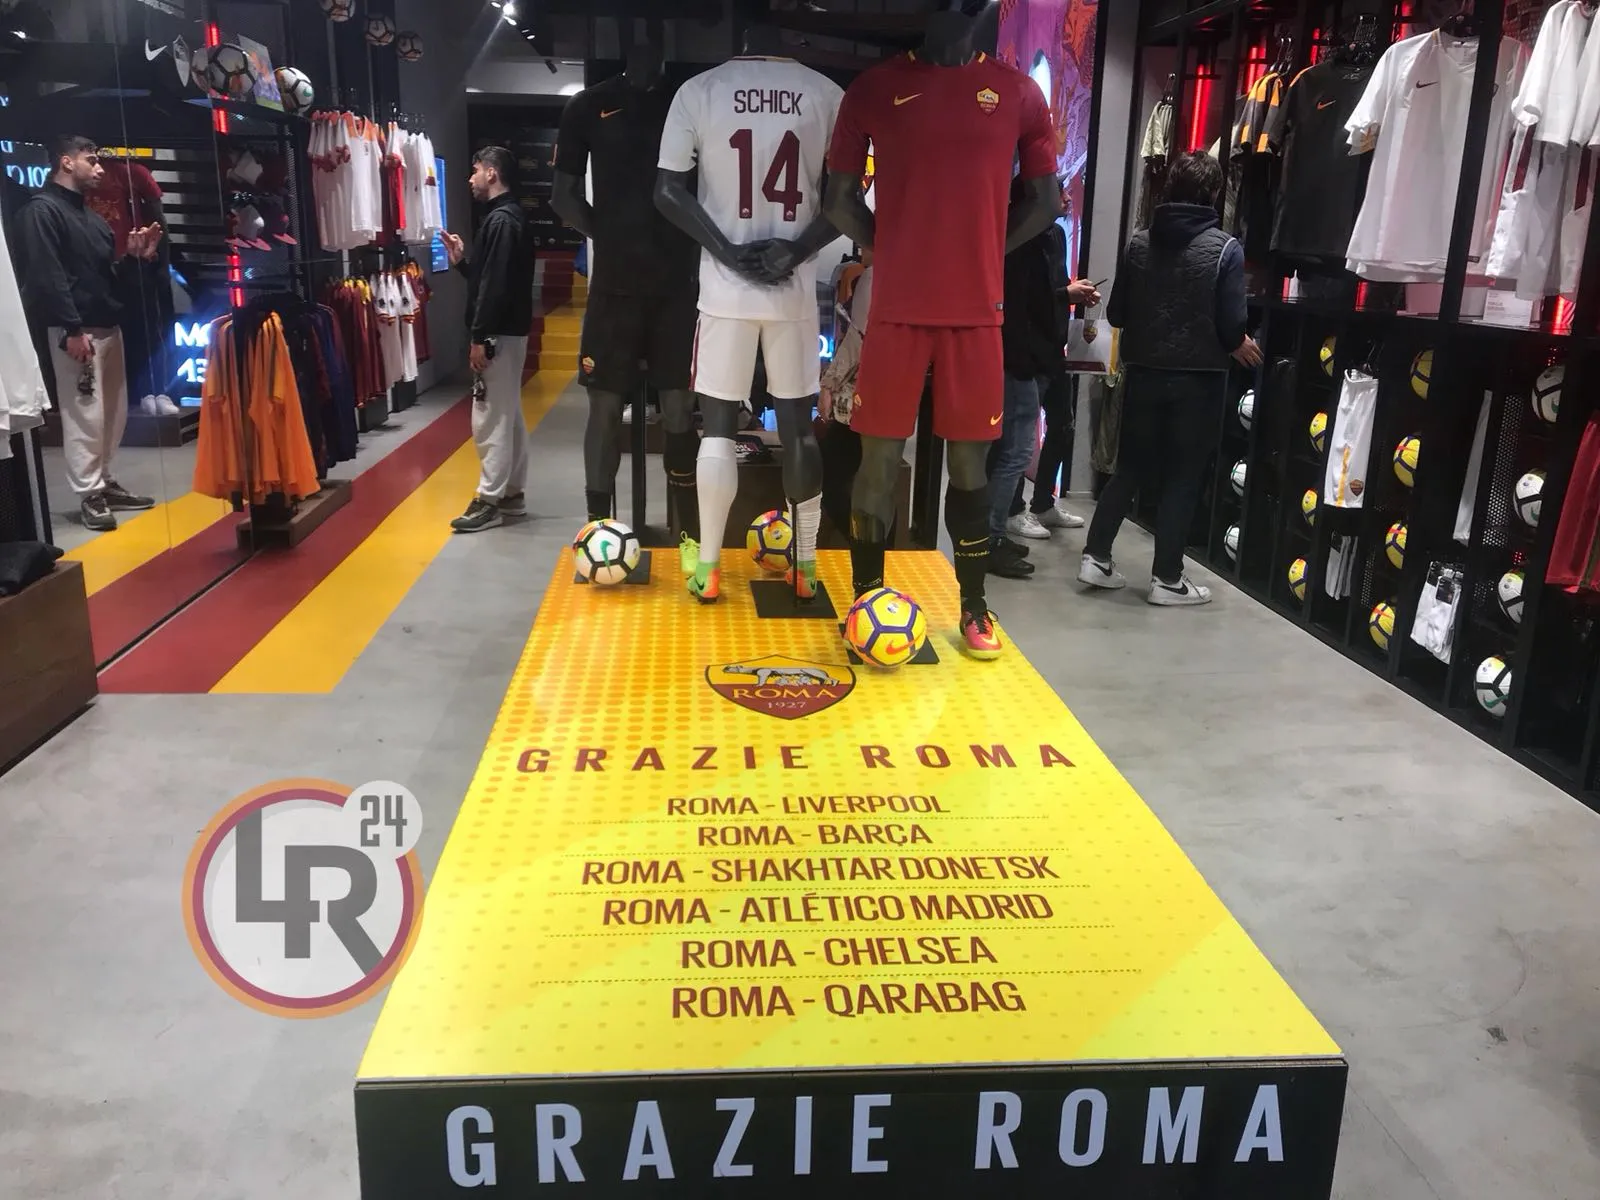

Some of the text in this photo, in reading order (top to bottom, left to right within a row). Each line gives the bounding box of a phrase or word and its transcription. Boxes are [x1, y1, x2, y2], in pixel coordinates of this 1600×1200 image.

[733, 88, 803, 116] SCHICK
[728, 128, 803, 222] 14
[732, 688, 838, 699] ROMA
[767, 701, 807, 709] 1927
[516, 744, 1076, 772] GRAZIE ROMA
[667, 797, 759, 816] ROMA
[782, 795, 951, 814] LIVERPOOL
[698, 826, 795, 847] ROMA
[818, 824, 933, 846] BARÇA
[582, 861, 685, 885] ROMA
[711, 857, 896, 882] SHAKHTAR
[898, 856, 1060, 881] DONETSK
[602, 898, 711, 926] ROMA
[740, 892, 906, 923] ATLÉTICO
[909, 894, 1054, 921] MADRID
[681, 939, 796, 969] ROMA
[823, 936, 998, 967] CHELSEA
[671, 985, 795, 1019] ROMA
[823, 981, 1028, 1018] QARABAG
[445, 1084, 1285, 1188] GRAZIE ROMA
